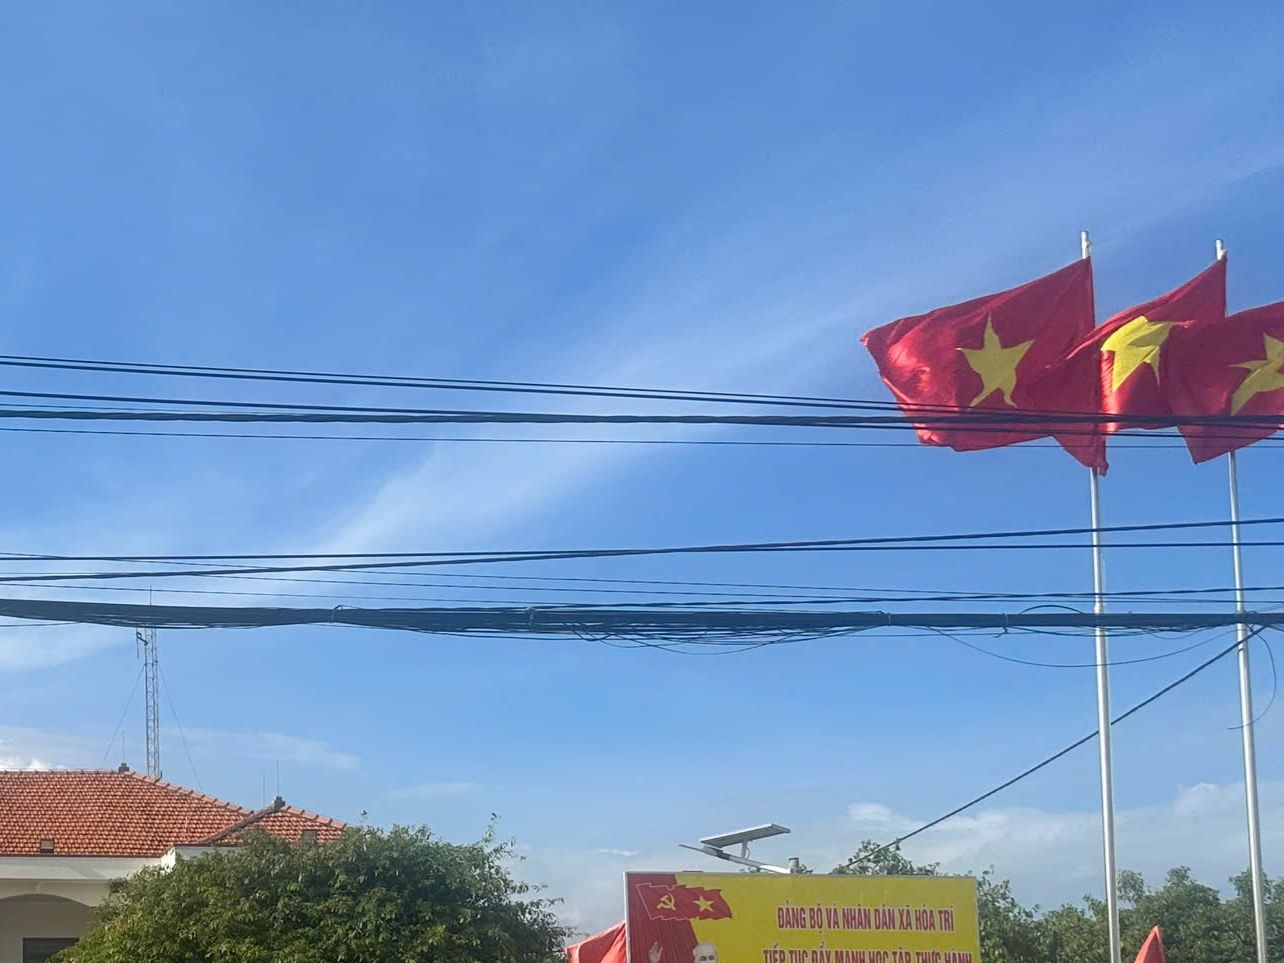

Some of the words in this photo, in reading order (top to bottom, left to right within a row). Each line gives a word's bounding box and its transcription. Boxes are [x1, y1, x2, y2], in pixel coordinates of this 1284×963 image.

[777, 900, 806, 929] ĐẢNG
[809, 903, 823, 933] BỘ
[826, 903, 839, 929] VÀ
[842, 904, 871, 929] NHÂN
[874, 904, 895, 930] DÂN
[898, 904, 912, 930] XÃ
[915, 904, 935, 931] HÒA
[938, 905, 954, 931] TRÍ
